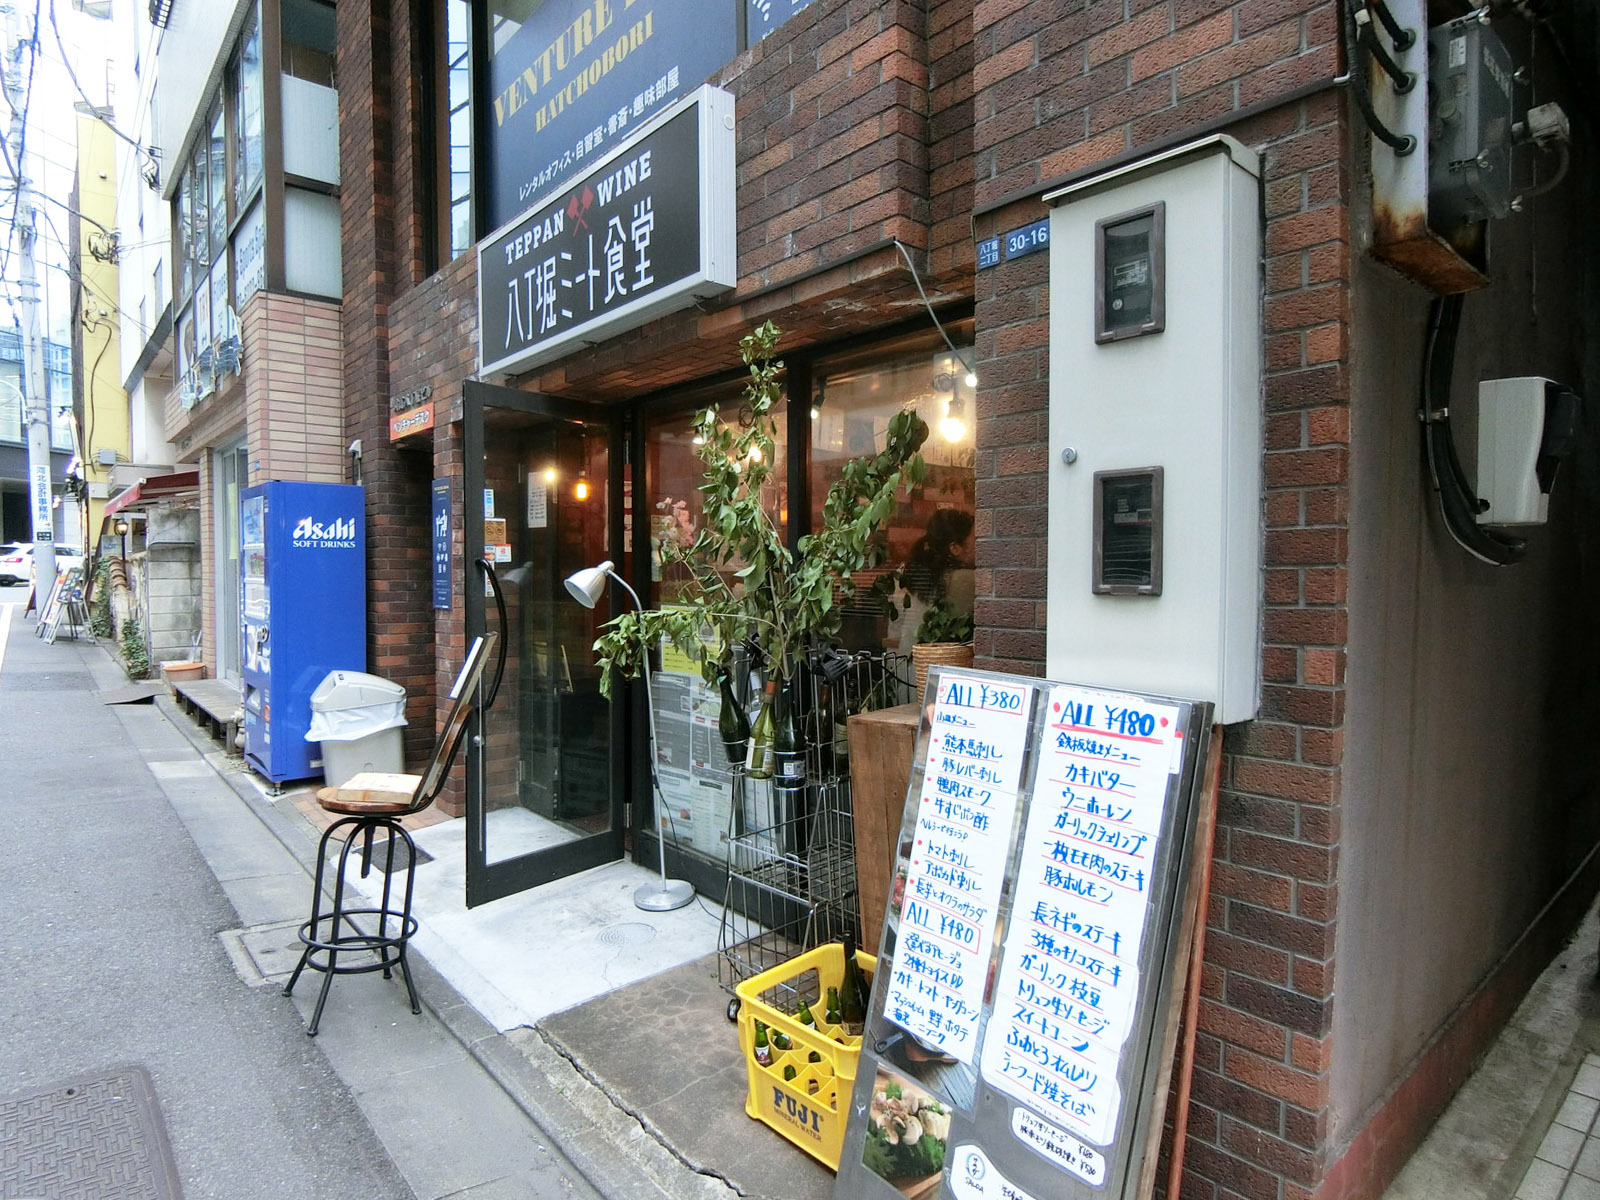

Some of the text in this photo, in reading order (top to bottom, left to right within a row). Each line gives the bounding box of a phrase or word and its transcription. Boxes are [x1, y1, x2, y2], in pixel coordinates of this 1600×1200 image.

[493, 0, 613, 127] VENTURE
[535, 10, 653, 133] HATCHOBORI
[505, 150, 652, 266] TEPPAN WINE
[980, 251, 999, 266] 二丁目
[1009, 227, 1048, 253] 30-16
[504, 196, 655, 350] 八丁堀ミート食堂
[293, 516, 356, 541] Asahi
[293, 540, 356, 549] SOFT DRINKS
[946, 683, 1021, 710] ALL ¥380
[1060, 700, 1155, 736] ALL ¥480
[942, 733, 1003, 759] 熊本馬刺し
[1065, 763, 1137, 790] カキバター
[1062, 787, 1133, 821] ウニホーレン
[1044, 865, 1113, 902] 豚ホルモン
[906, 902, 974, 944] ALL ¥480
[1030, 901, 1122, 956] 長ネギのステーキ
[1030, 928, 1122, 987] 3種のキノコステーキ
[1012, 1002, 1089, 1052] スイートコーン
[772, 1085, 820, 1132] FUJI
